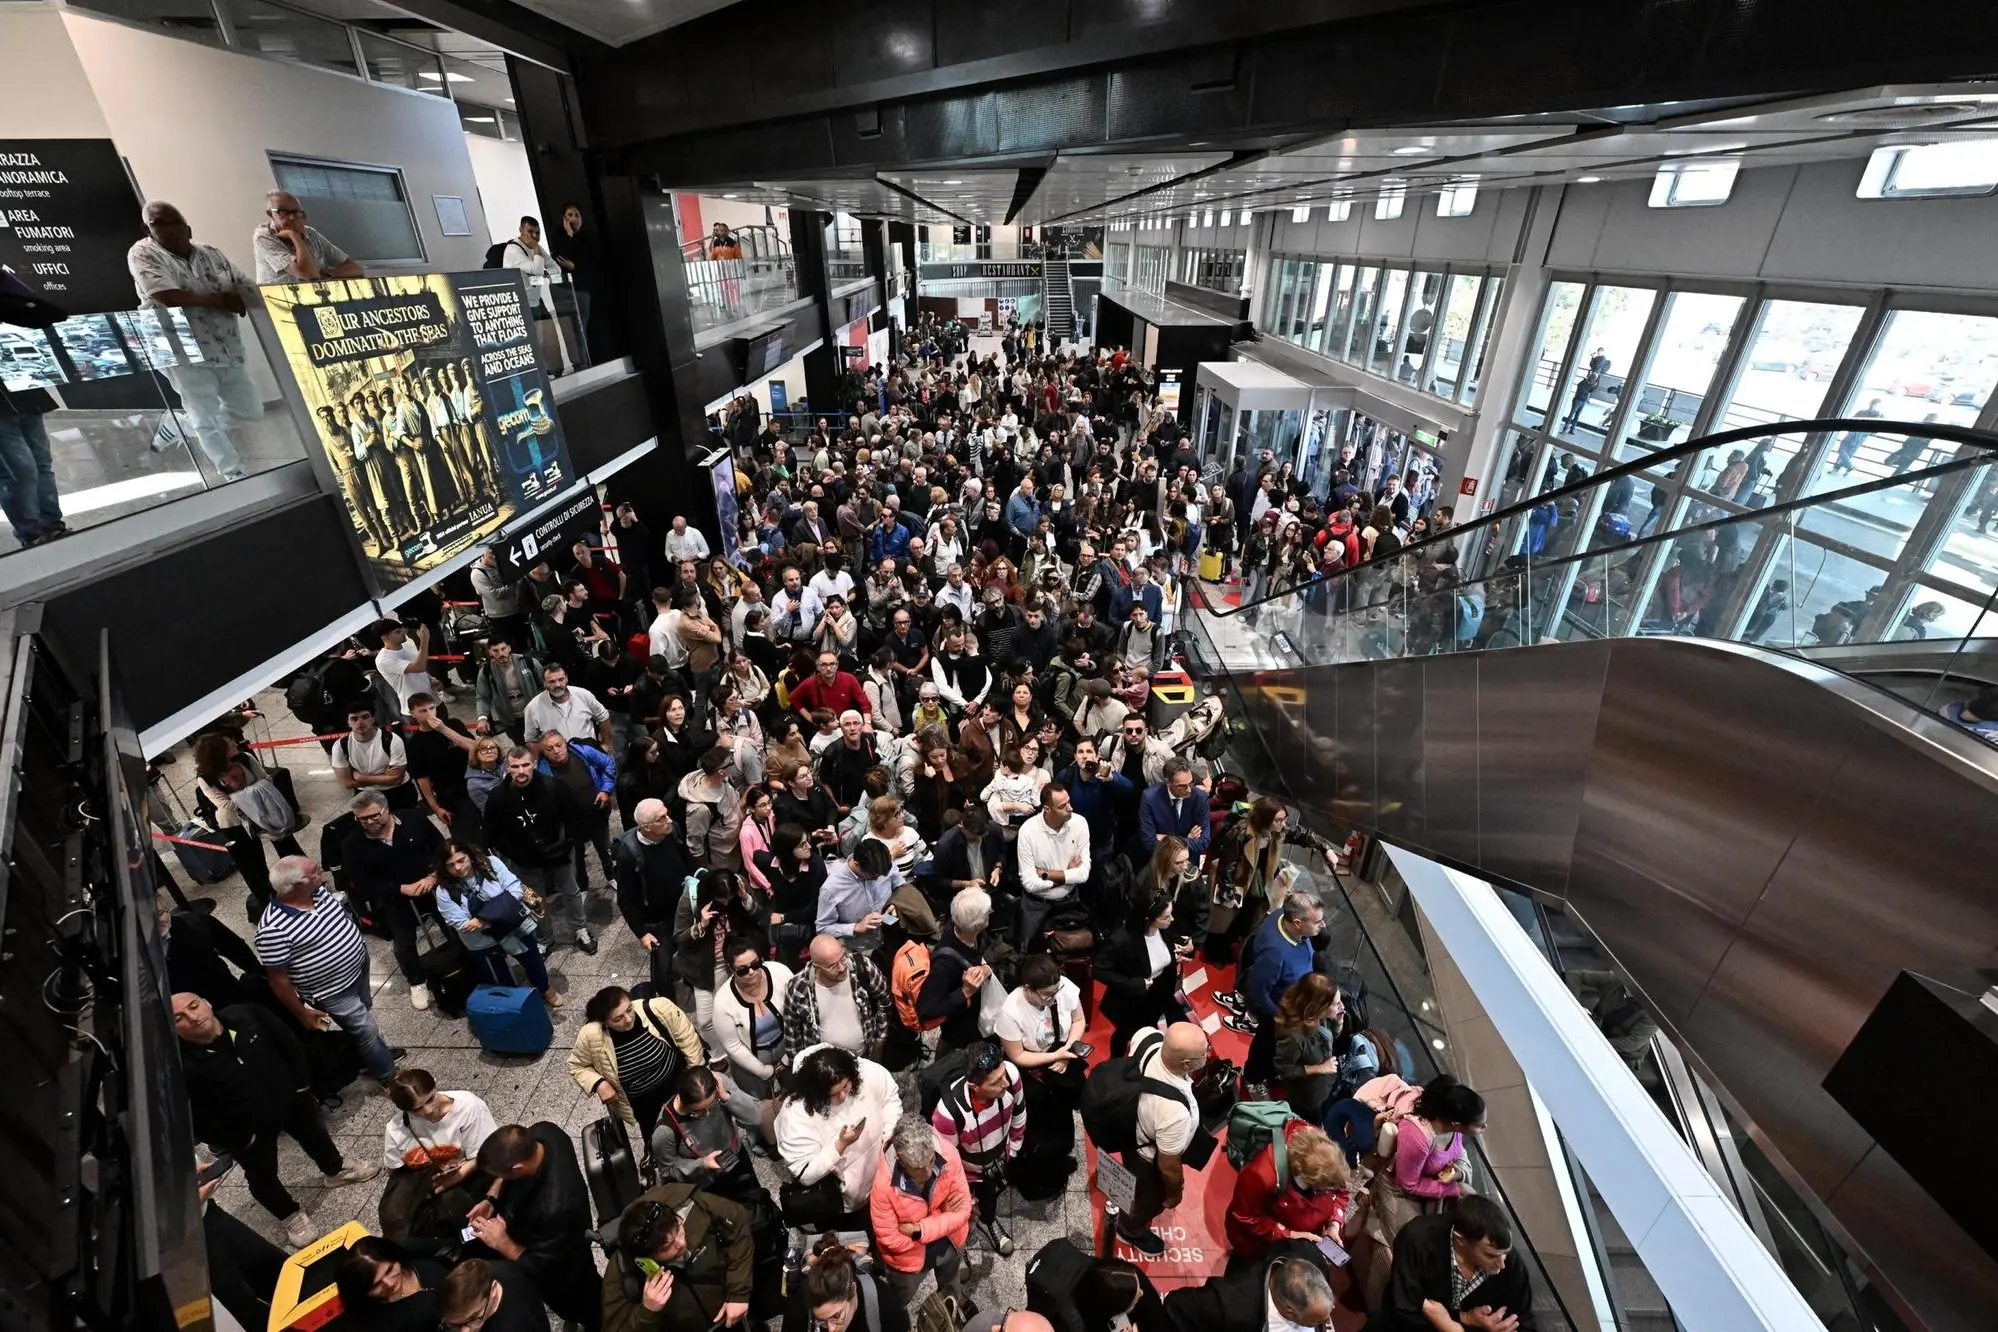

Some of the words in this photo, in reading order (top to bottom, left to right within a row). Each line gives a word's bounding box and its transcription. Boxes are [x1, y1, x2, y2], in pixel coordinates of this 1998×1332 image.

[0, 153, 41, 166] RAZZA
[23, 189, 50, 198] terrace
[8, 210, 40, 222] AREA
[14, 226, 74, 238] FUMATORI
[23, 243, 54, 254] smoking
[32, 263, 70, 274] UFFICI
[982, 264, 1030, 277] RESTAURANT
[43, 281, 67, 290] offices
[461, 294, 479, 308] WE
[479, 292, 512, 307] PROVIDE
[512, 292, 519, 302] &
[361, 304, 430, 328] ANCESTORS
[466, 306, 487, 322] GIVE
[486, 304, 521, 319] SUPPORT
[470, 320, 483, 334] TO
[484, 315, 525, 332] ANYTHING
[311, 331, 400, 361] DOMINATED
[395, 328, 420, 347] THE
[418, 324, 448, 344] SEAS
[473, 332, 497, 348] THAT
[497, 326, 528, 342] FLOATS
[481, 351, 505, 364] ACROSS
[505, 346, 518, 358] THE
[517, 344, 532, 355] SEAS
[484, 361, 503, 376] AND
[503, 353, 535, 370] OCEANS
[468, 502, 494, 522] IANUA
[535, 514, 564, 539] CONTROLLI
[564, 511, 570, 521] DI
[569, 495, 595, 517] SICUREZZA
[1150, 1226, 1187, 1242] CHE
